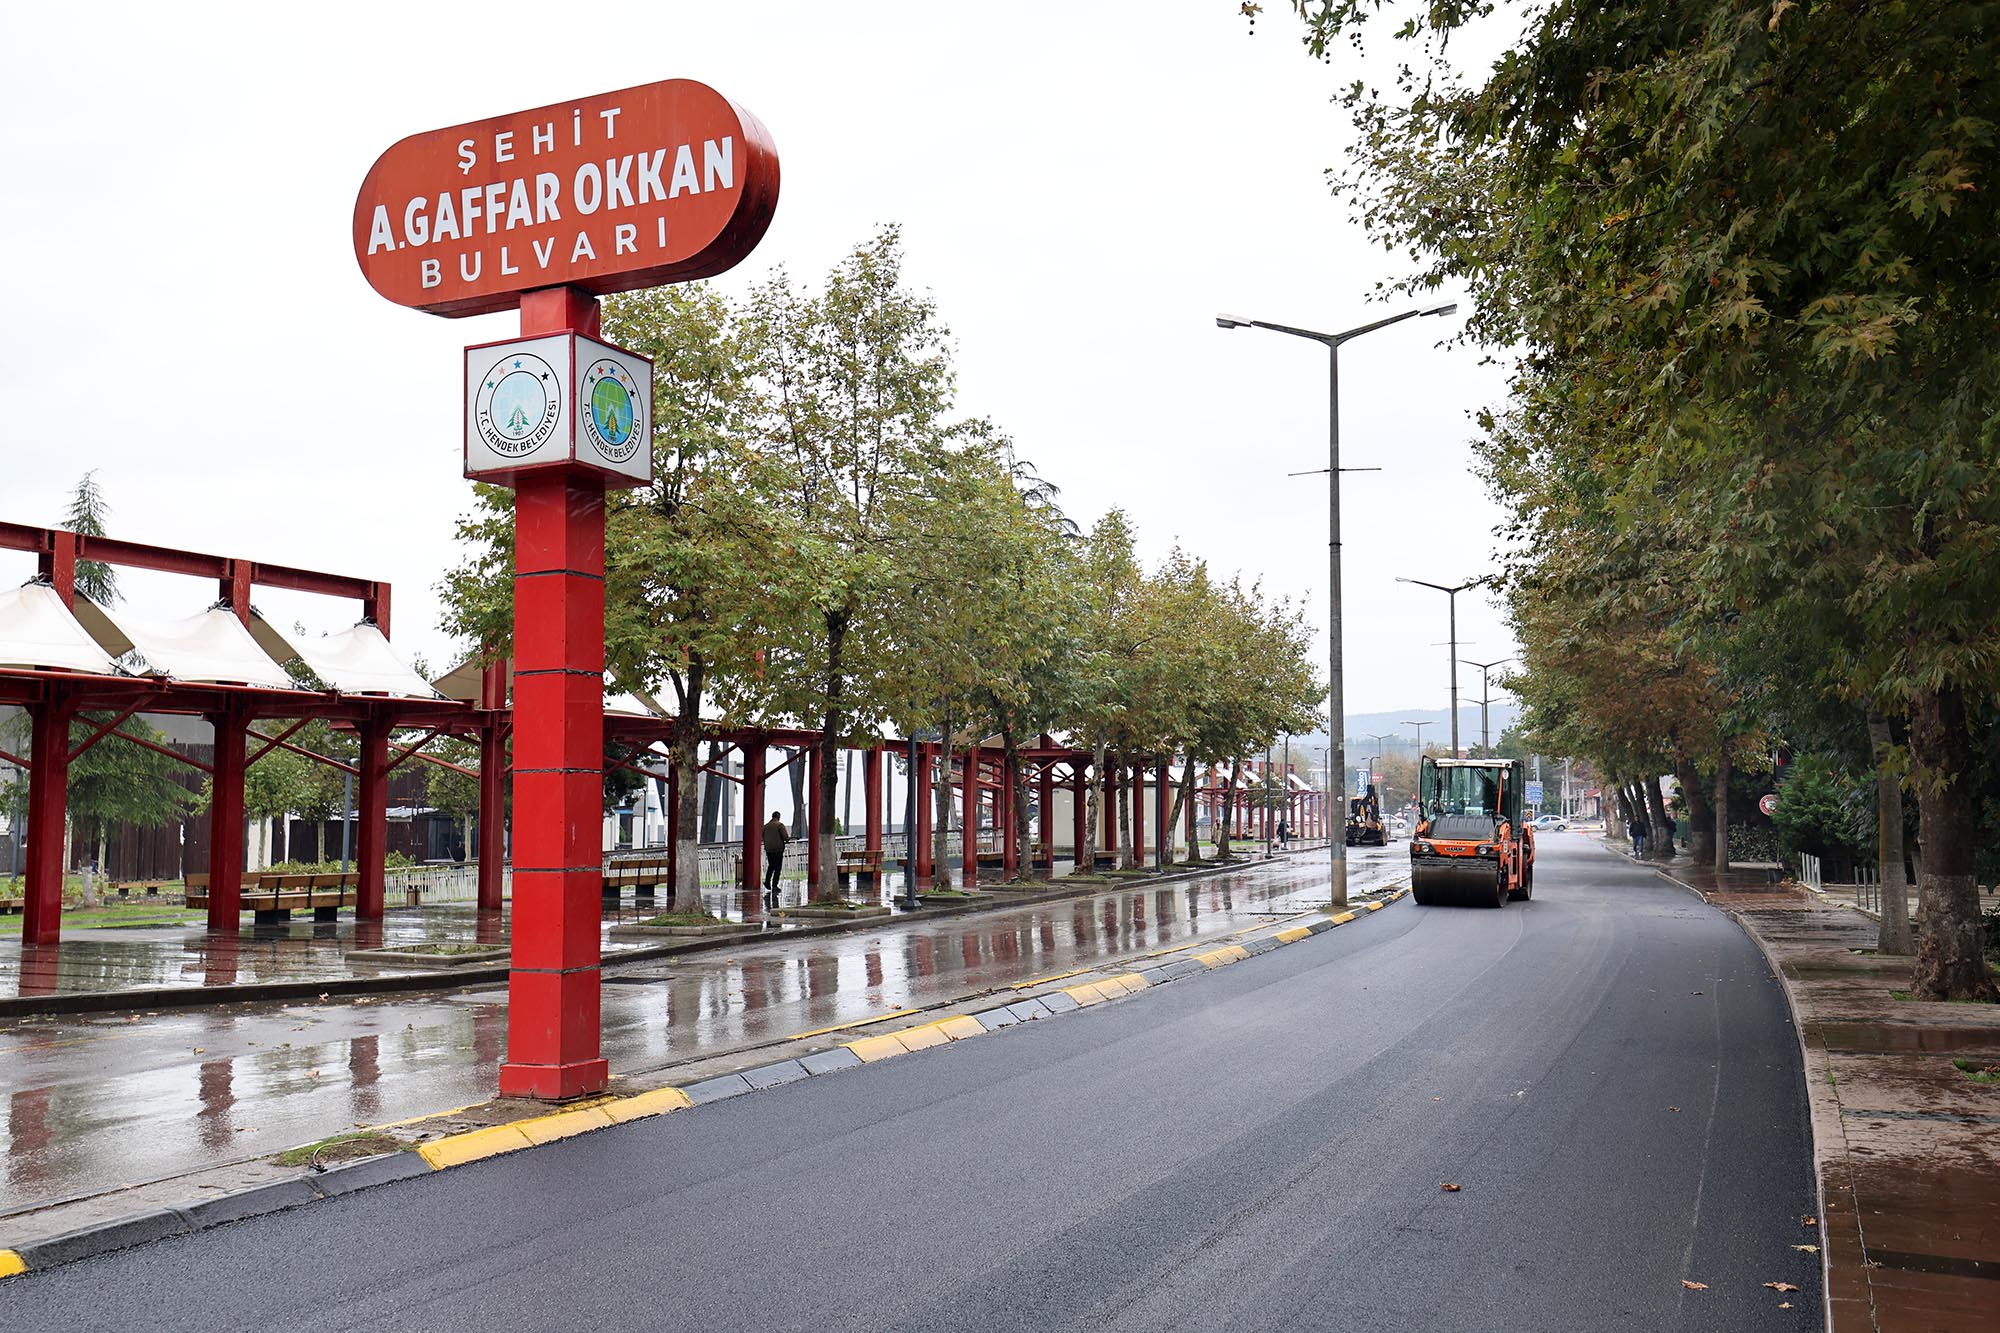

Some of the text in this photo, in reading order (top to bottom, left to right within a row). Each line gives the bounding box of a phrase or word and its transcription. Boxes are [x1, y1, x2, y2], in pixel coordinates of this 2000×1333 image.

[457, 107, 621, 175] ŞEHİT
[367, 135, 734, 255] A.GAFFAR OKKAN
[421, 216, 667, 289] BULVARI
[480, 400, 557, 453] T.C. HENDEK BELEDİYESİ
[588, 423, 614, 457] HENDEK
